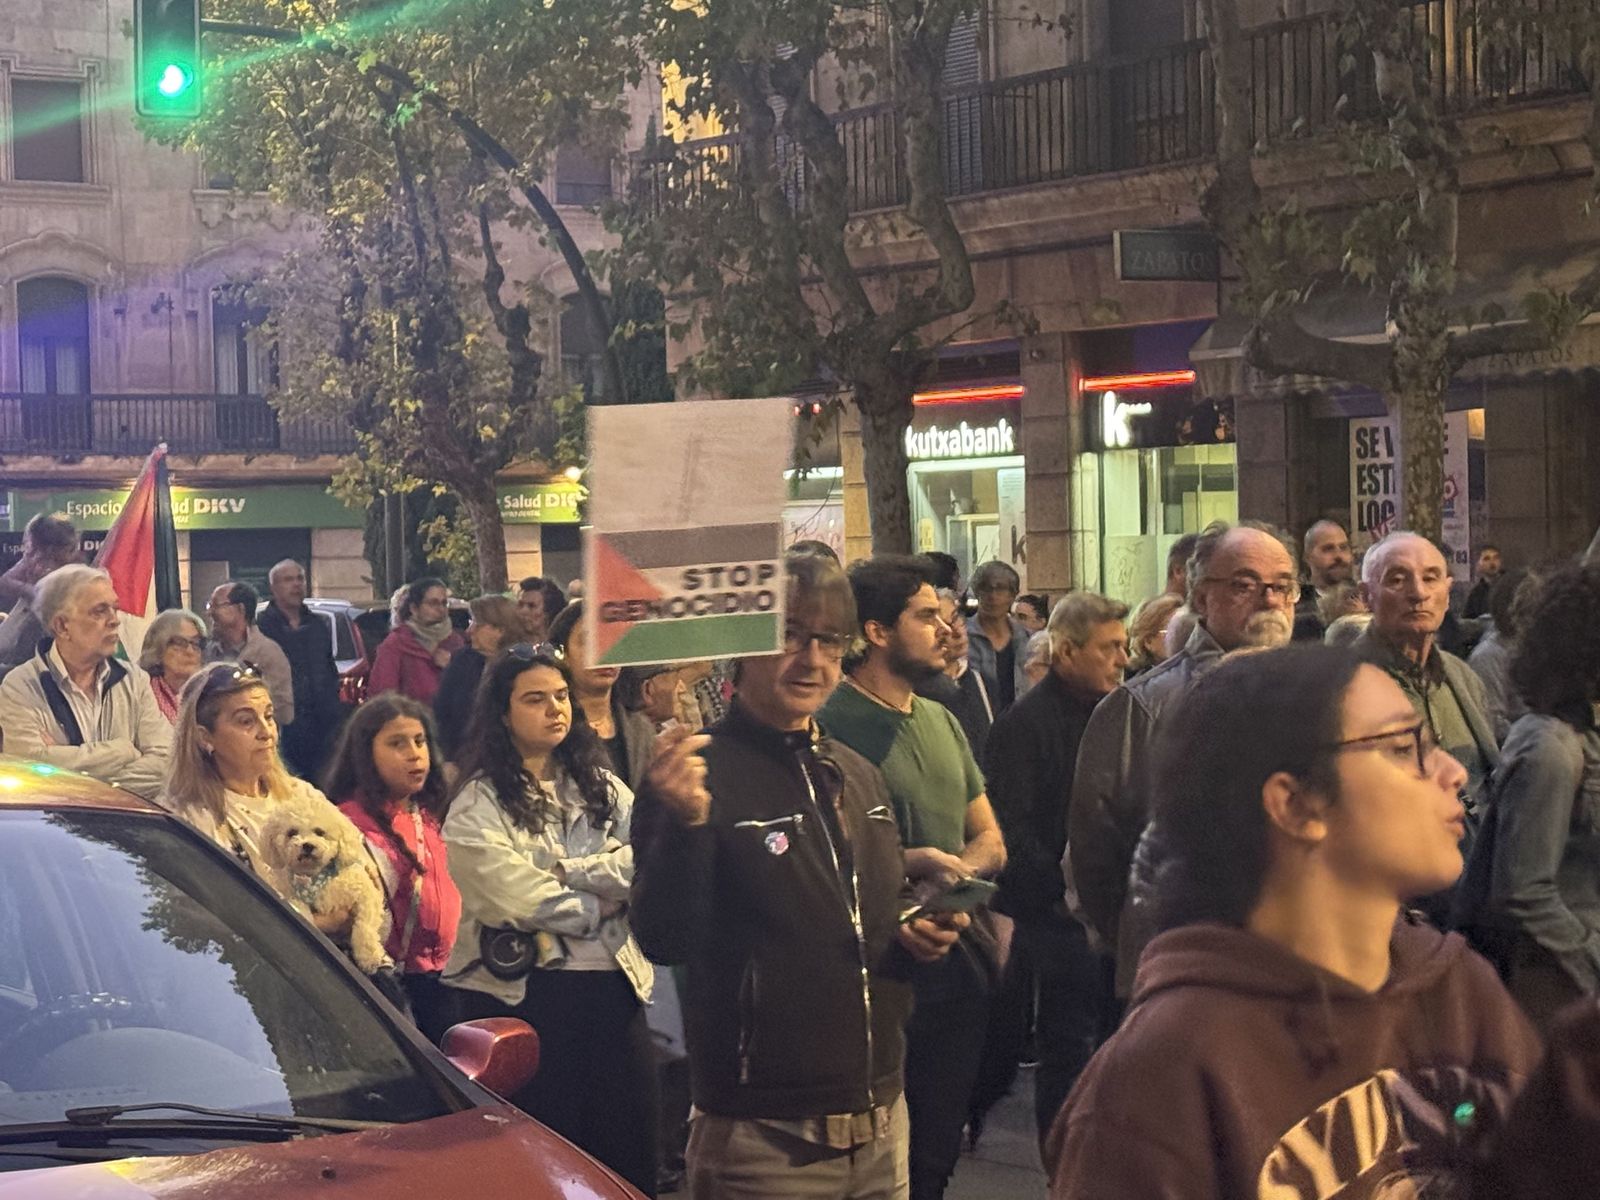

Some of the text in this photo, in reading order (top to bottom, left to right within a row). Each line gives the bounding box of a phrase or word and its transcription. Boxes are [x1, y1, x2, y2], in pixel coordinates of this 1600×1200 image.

[905, 418, 1015, 458] kutxabank
[1356, 426, 1380, 459] SE
[66, 499, 122, 519] Espacio
[193, 497, 246, 514] DKV
[504, 492, 578, 508] Salud DK
[683, 563, 775, 590] STOP
